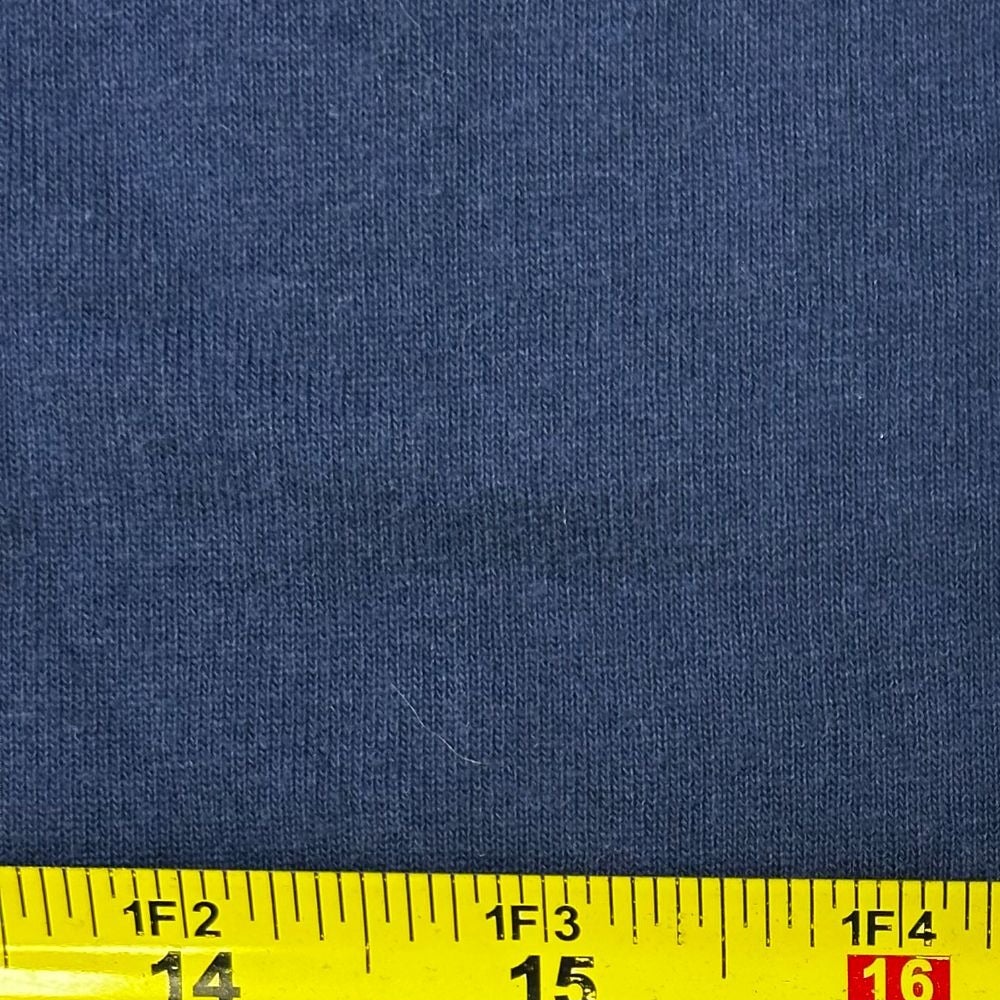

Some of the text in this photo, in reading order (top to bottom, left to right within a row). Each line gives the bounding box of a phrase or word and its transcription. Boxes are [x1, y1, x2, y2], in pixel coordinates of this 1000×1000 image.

[123, 901, 221, 938] 1F 2
[485, 905, 581, 942] 1F 3
[842, 910, 937, 947] 1F 4
